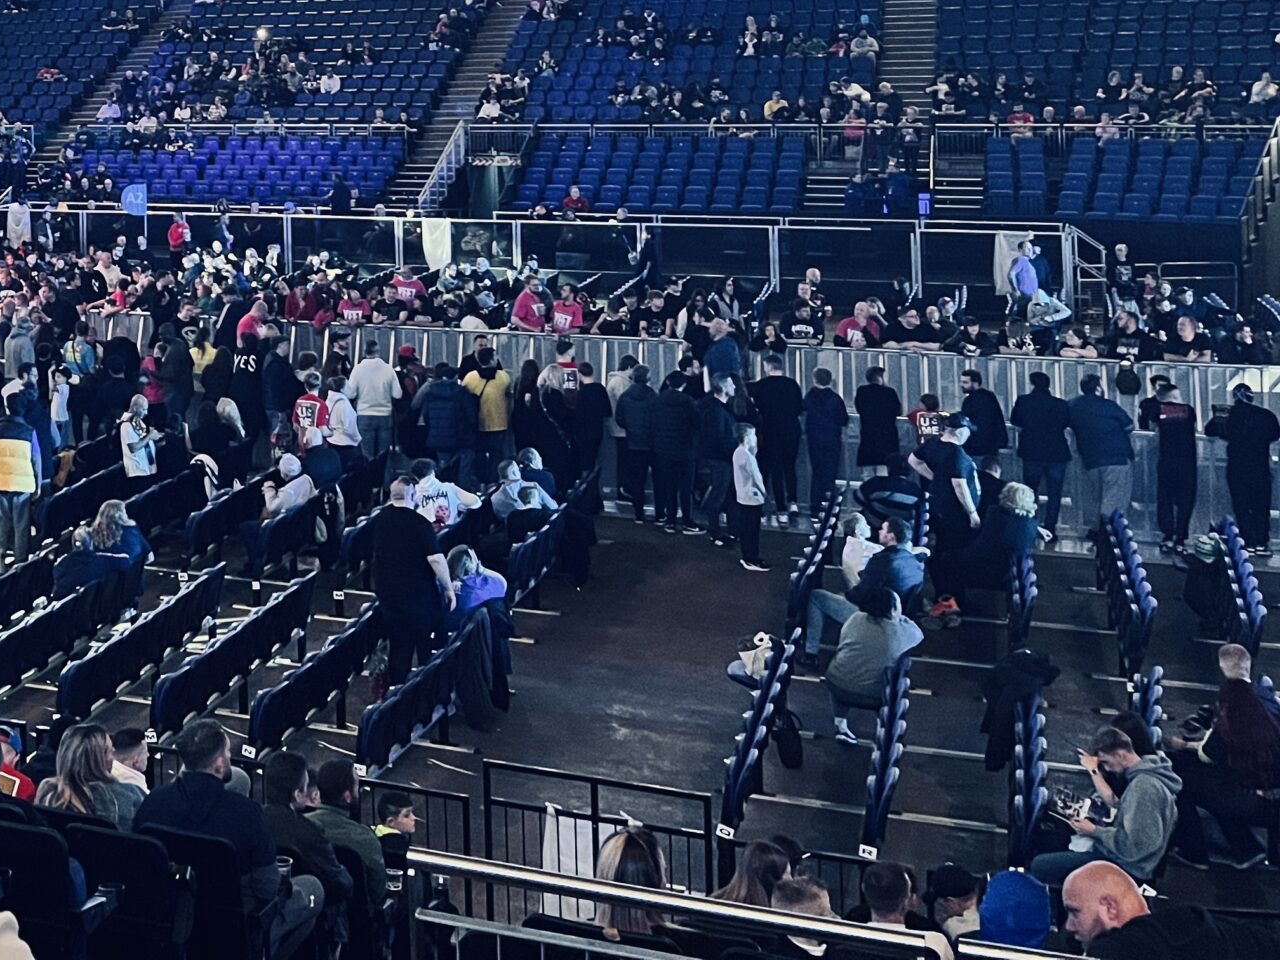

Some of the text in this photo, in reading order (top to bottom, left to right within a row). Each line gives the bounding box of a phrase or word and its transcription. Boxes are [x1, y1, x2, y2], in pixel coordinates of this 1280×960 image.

[126, 192, 143, 204] A2
[233, 353, 257, 374] YES
[921, 426, 940, 435] ME
